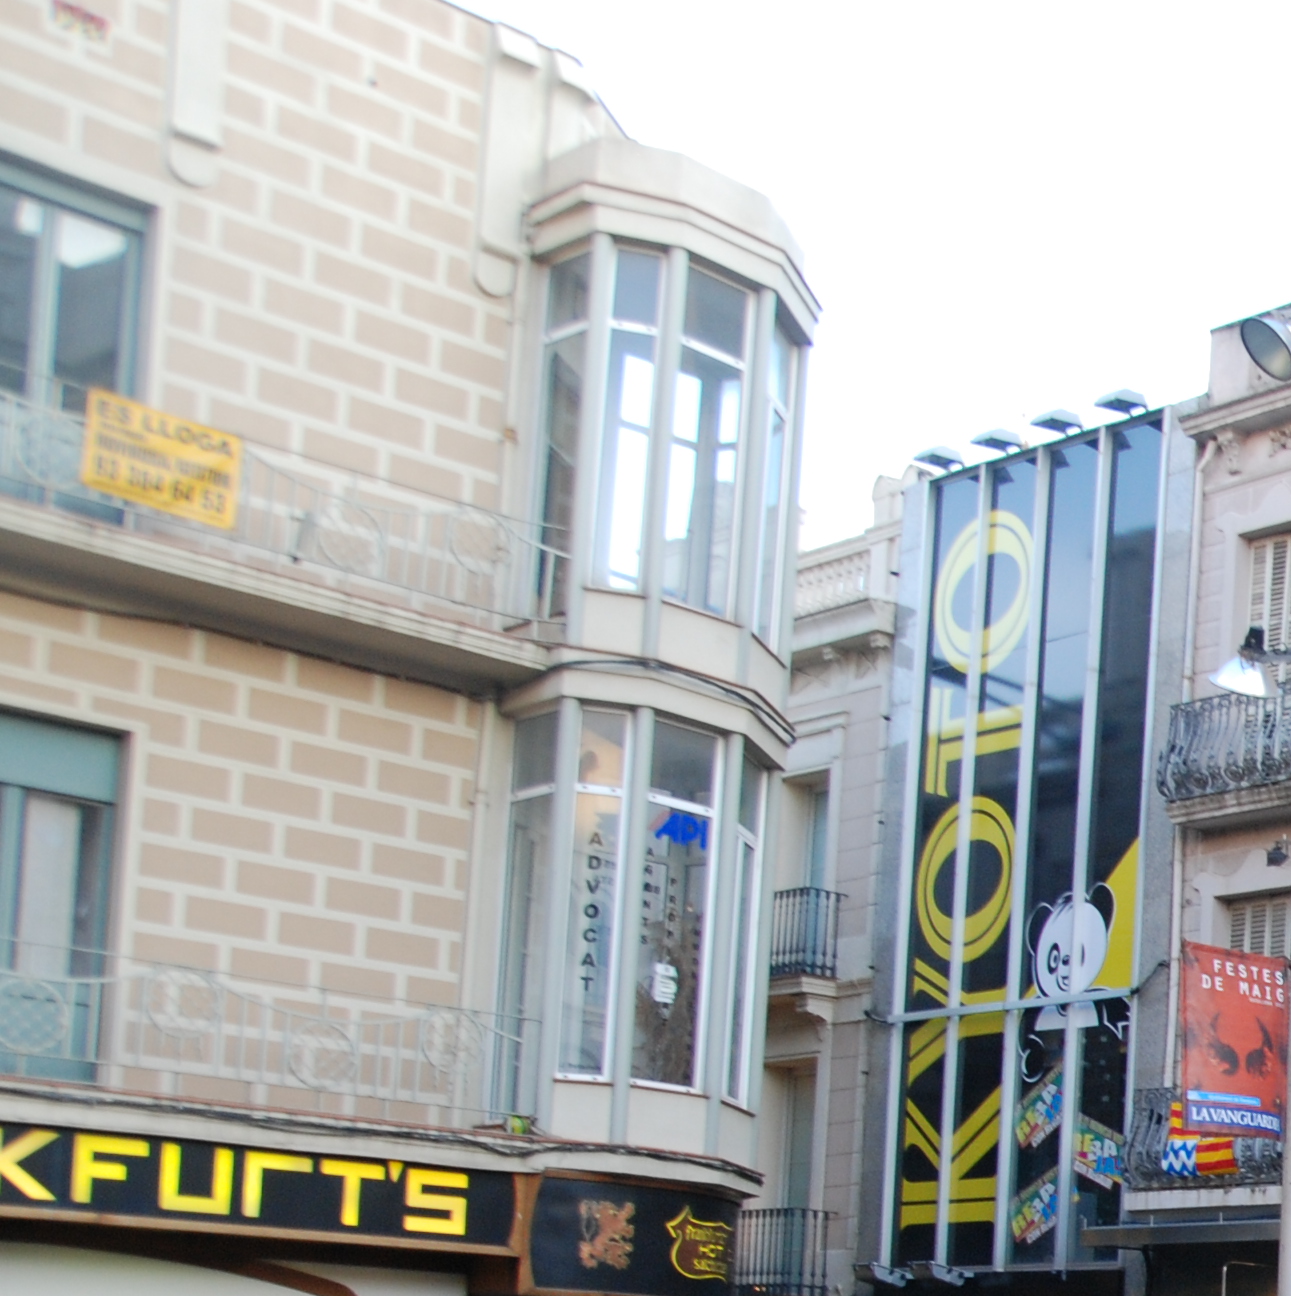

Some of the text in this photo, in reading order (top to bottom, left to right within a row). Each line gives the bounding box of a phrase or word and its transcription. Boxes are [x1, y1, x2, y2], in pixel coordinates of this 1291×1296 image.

[96, 399, 132, 425] ES
[142, 414, 233, 459] LLOGA
[900, 510, 1035, 1230] KYOTO
[580, 832, 604, 993] ADVOCAT
[1201, 973, 1225, 992] DE
[1238, 981, 1285, 1003] MAIG
[1213, 958, 1285, 986] FESTES
